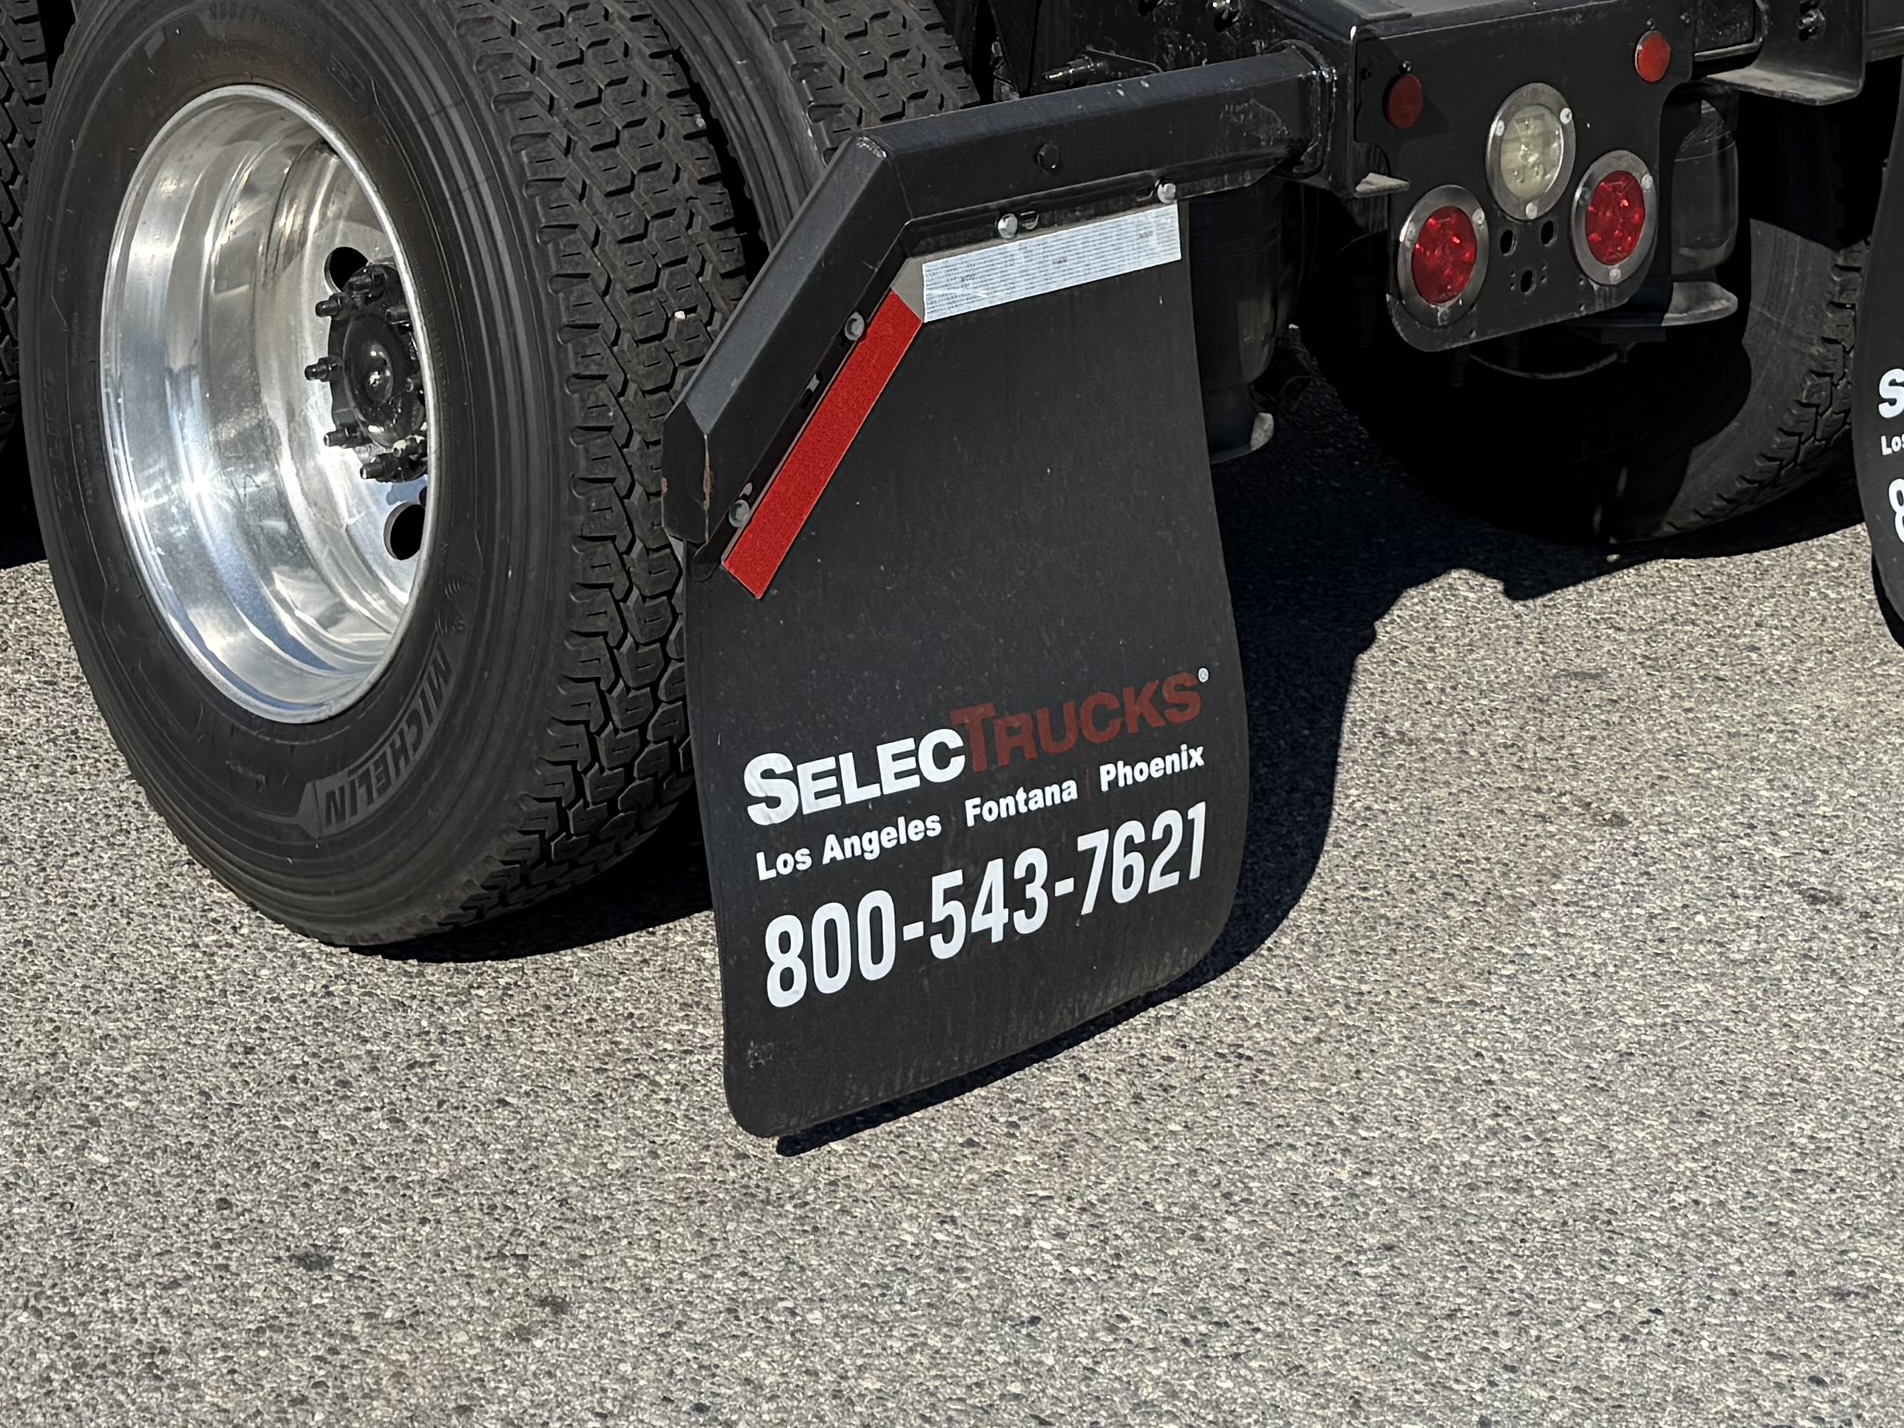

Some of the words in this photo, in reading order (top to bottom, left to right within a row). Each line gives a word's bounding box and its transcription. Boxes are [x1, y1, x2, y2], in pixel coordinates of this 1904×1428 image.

[323, 643, 453, 828] MICHELIN
[743, 672, 1203, 826] SELECTRUCKS
[756, 845, 812, 880] Los
[822, 814, 942, 864] Angeles
[965, 779, 1078, 827] Fontana
[1099, 744, 1205, 791] Phoenix
[764, 801, 1207, 1008] 800-543-7621
